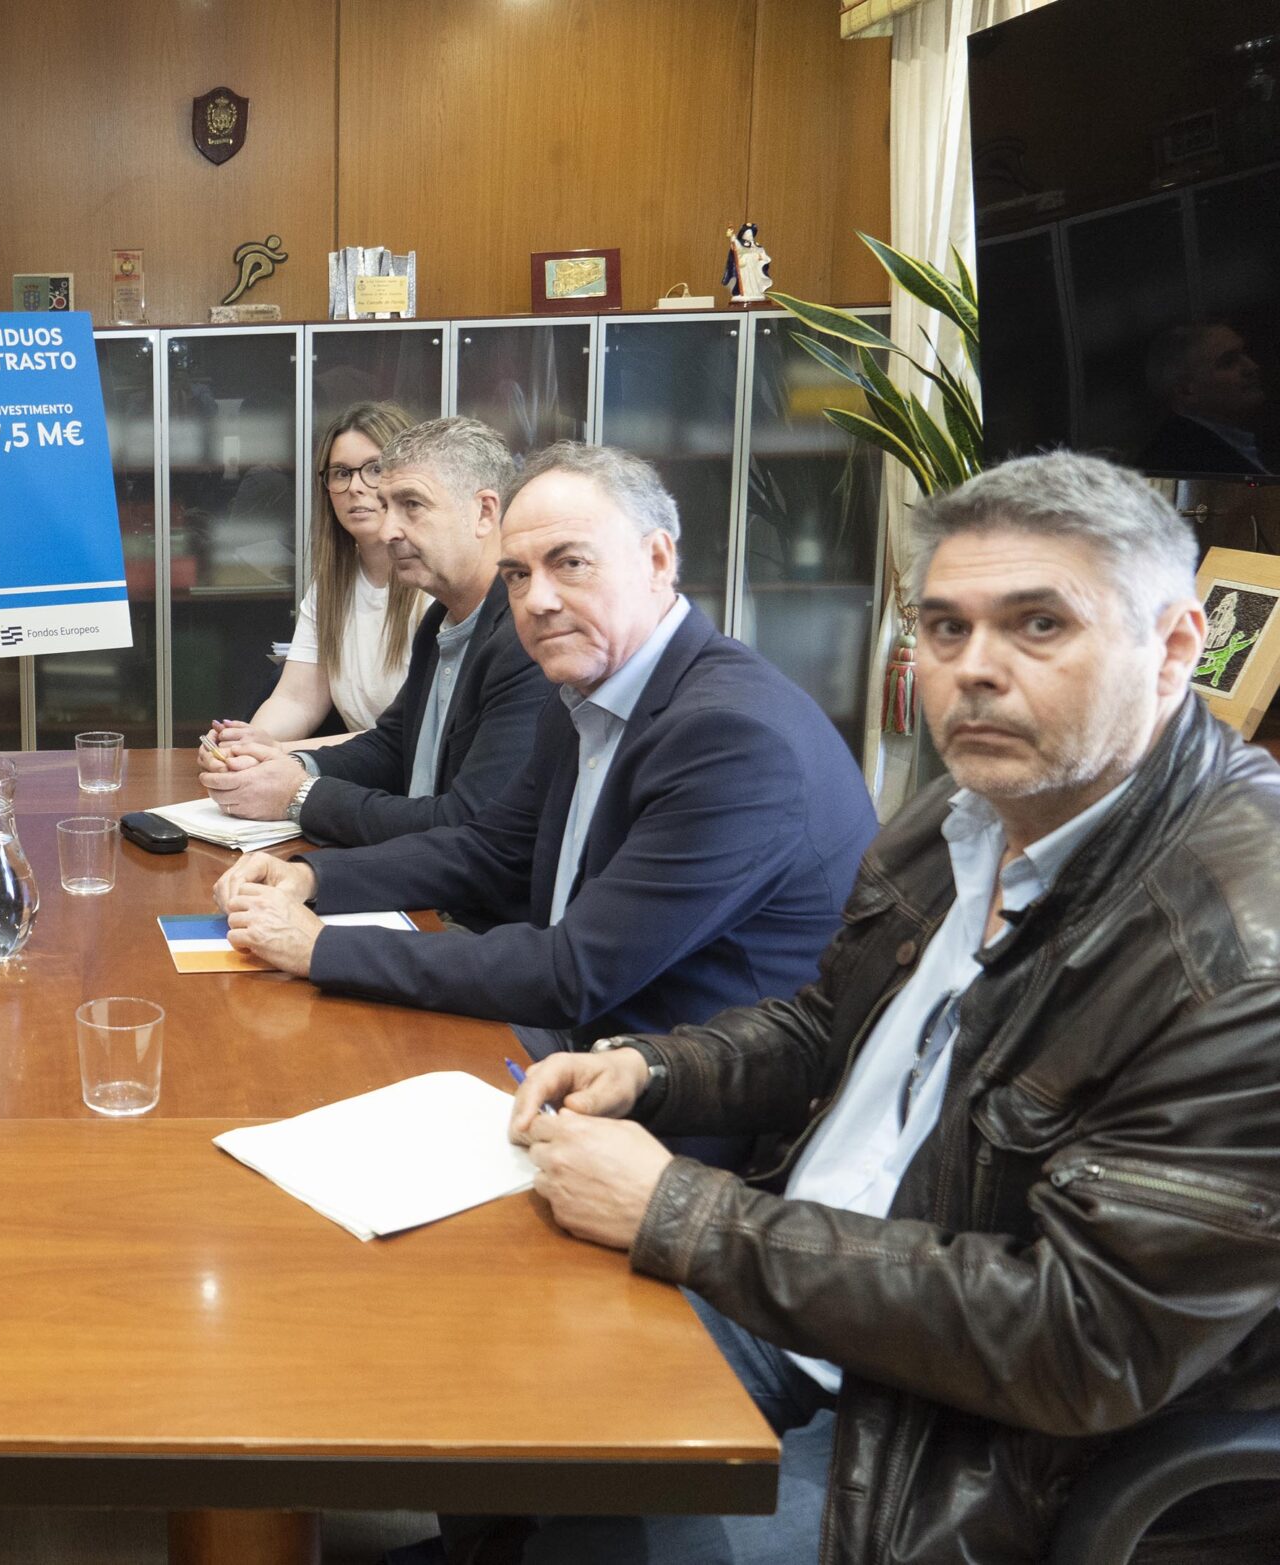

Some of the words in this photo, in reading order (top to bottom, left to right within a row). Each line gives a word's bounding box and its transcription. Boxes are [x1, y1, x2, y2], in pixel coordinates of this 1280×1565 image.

[37, 420, 84, 447] M€
[27, 628, 58, 638] Fondos
[60, 626, 100, 636] Europeos
